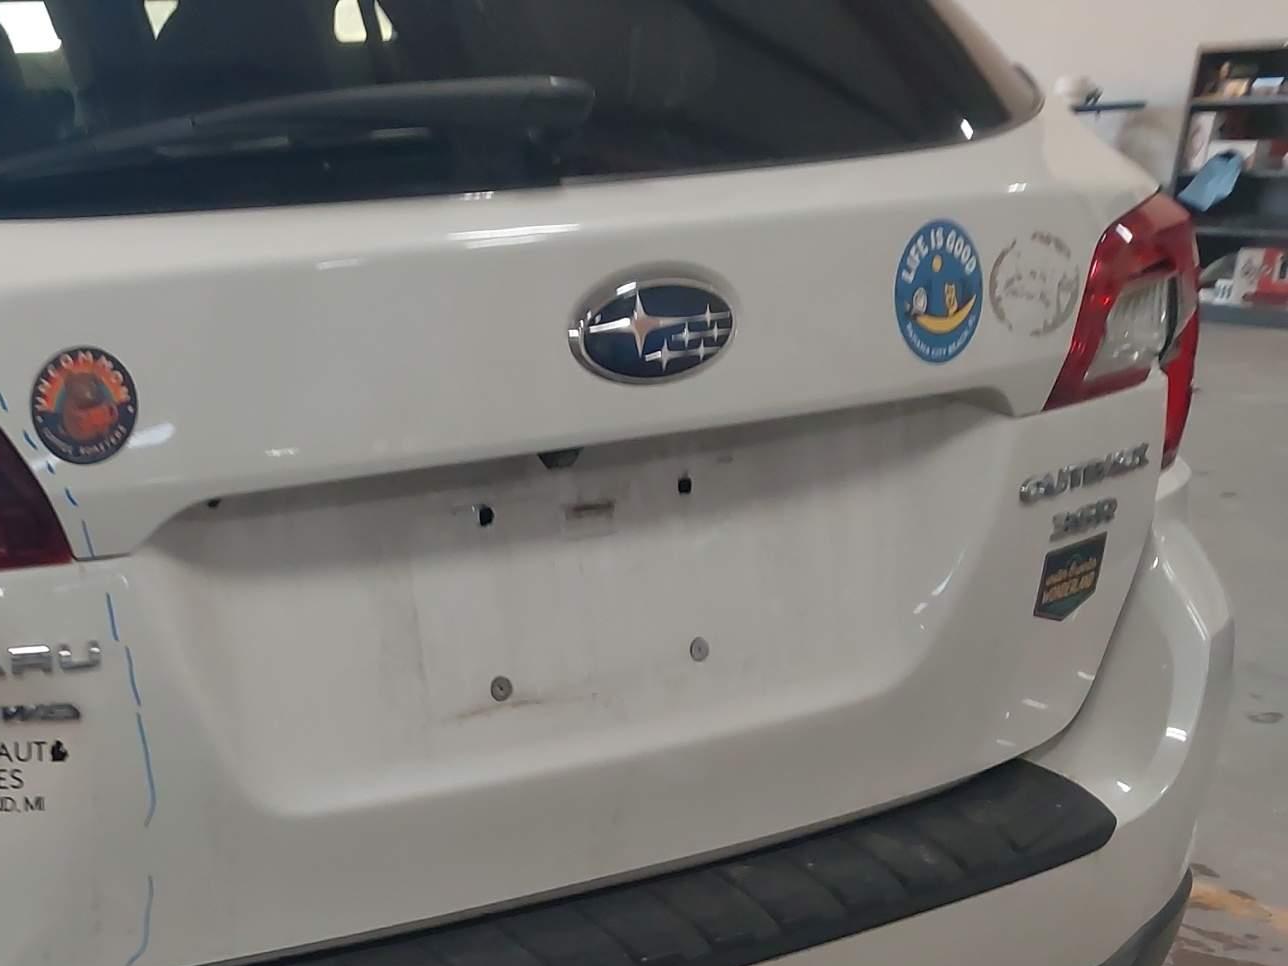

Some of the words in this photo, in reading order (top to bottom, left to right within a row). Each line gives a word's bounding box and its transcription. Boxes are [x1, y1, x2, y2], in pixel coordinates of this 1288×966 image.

[902, 235, 929, 284] LIFE
[931, 227, 944, 250] IS
[946, 229, 977, 277] GOOD
[34, 349, 131, 412] UNCOMMON
[23, 796, 46, 812] MI
